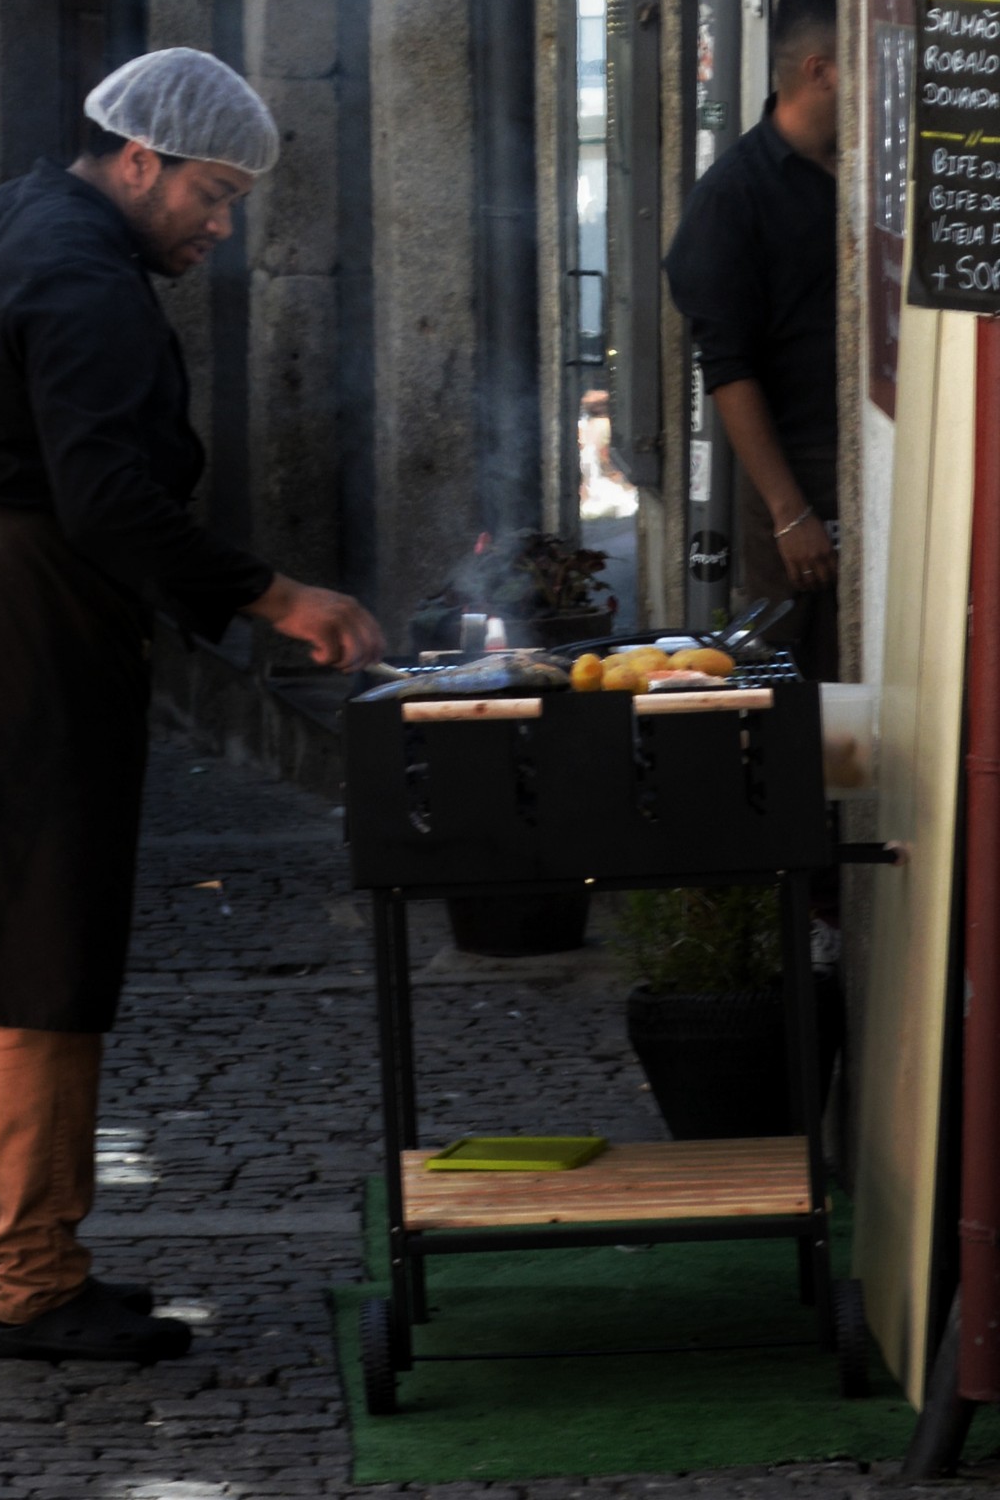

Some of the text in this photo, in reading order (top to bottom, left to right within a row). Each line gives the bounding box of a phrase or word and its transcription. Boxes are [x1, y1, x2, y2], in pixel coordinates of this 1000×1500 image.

[924, 44, 1000, 74] ROBALO
[922, 82, 1000, 110] DOURADA
[932, 147, 980, 179] BIFE
[929, 184, 979, 211] BIFE
[931, 214, 986, 246] VITELA
